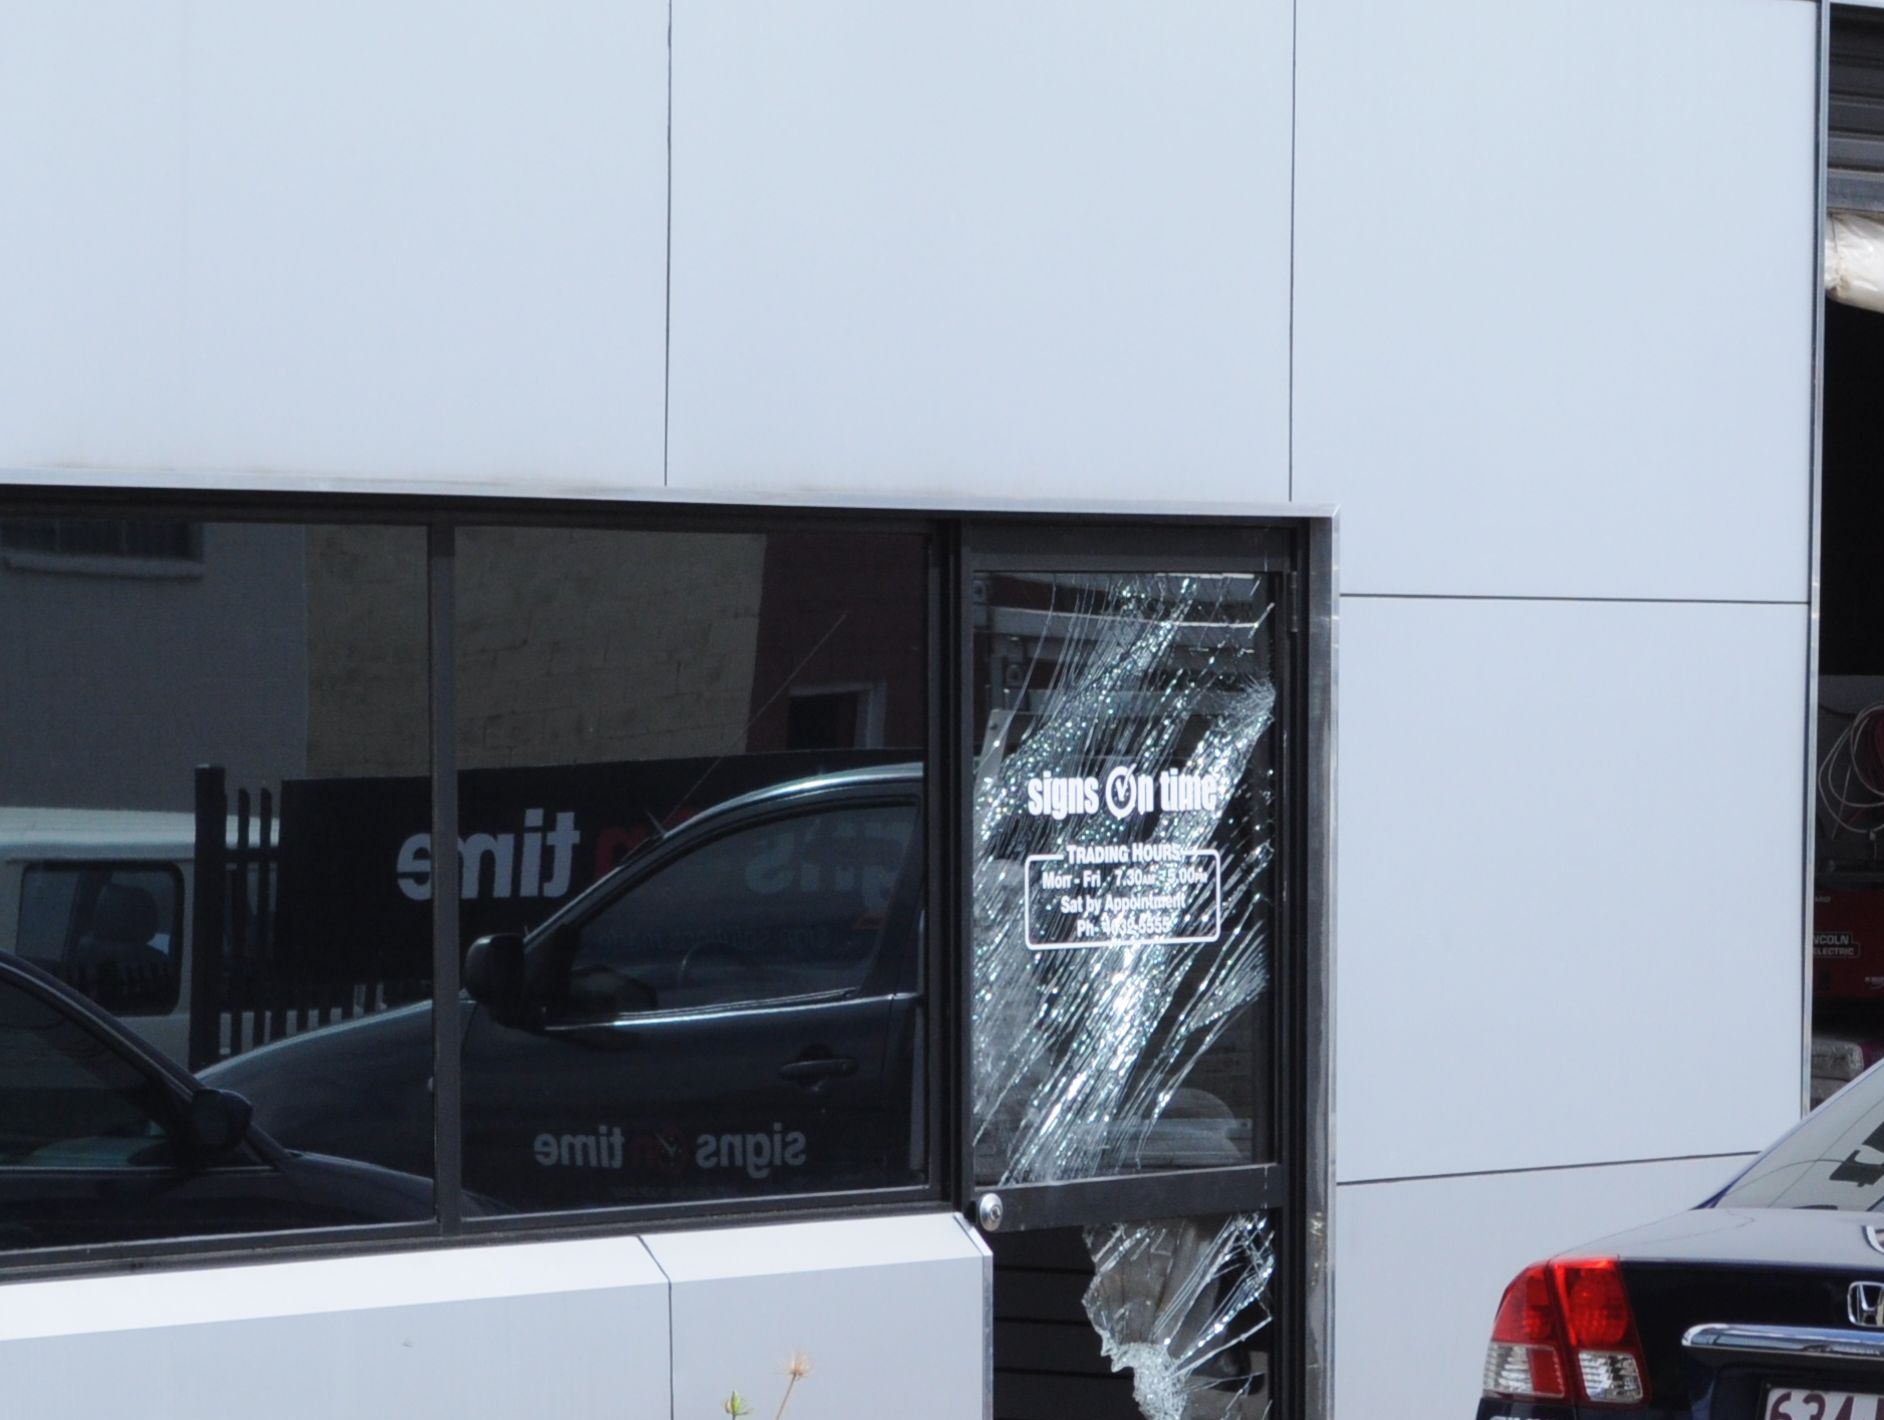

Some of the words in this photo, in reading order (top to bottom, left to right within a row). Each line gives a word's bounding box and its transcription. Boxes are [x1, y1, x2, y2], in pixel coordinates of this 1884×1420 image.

[1028, 771, 1100, 820] signs
[1159, 768, 1218, 812] time
[1066, 845, 1130, 865] TRADING
[1132, 843, 1182, 863] HOURS
[1083, 868, 1101, 888] Fri
[1061, 895, 1083, 914] Sat
[1104, 891, 1186, 914] Appointment
